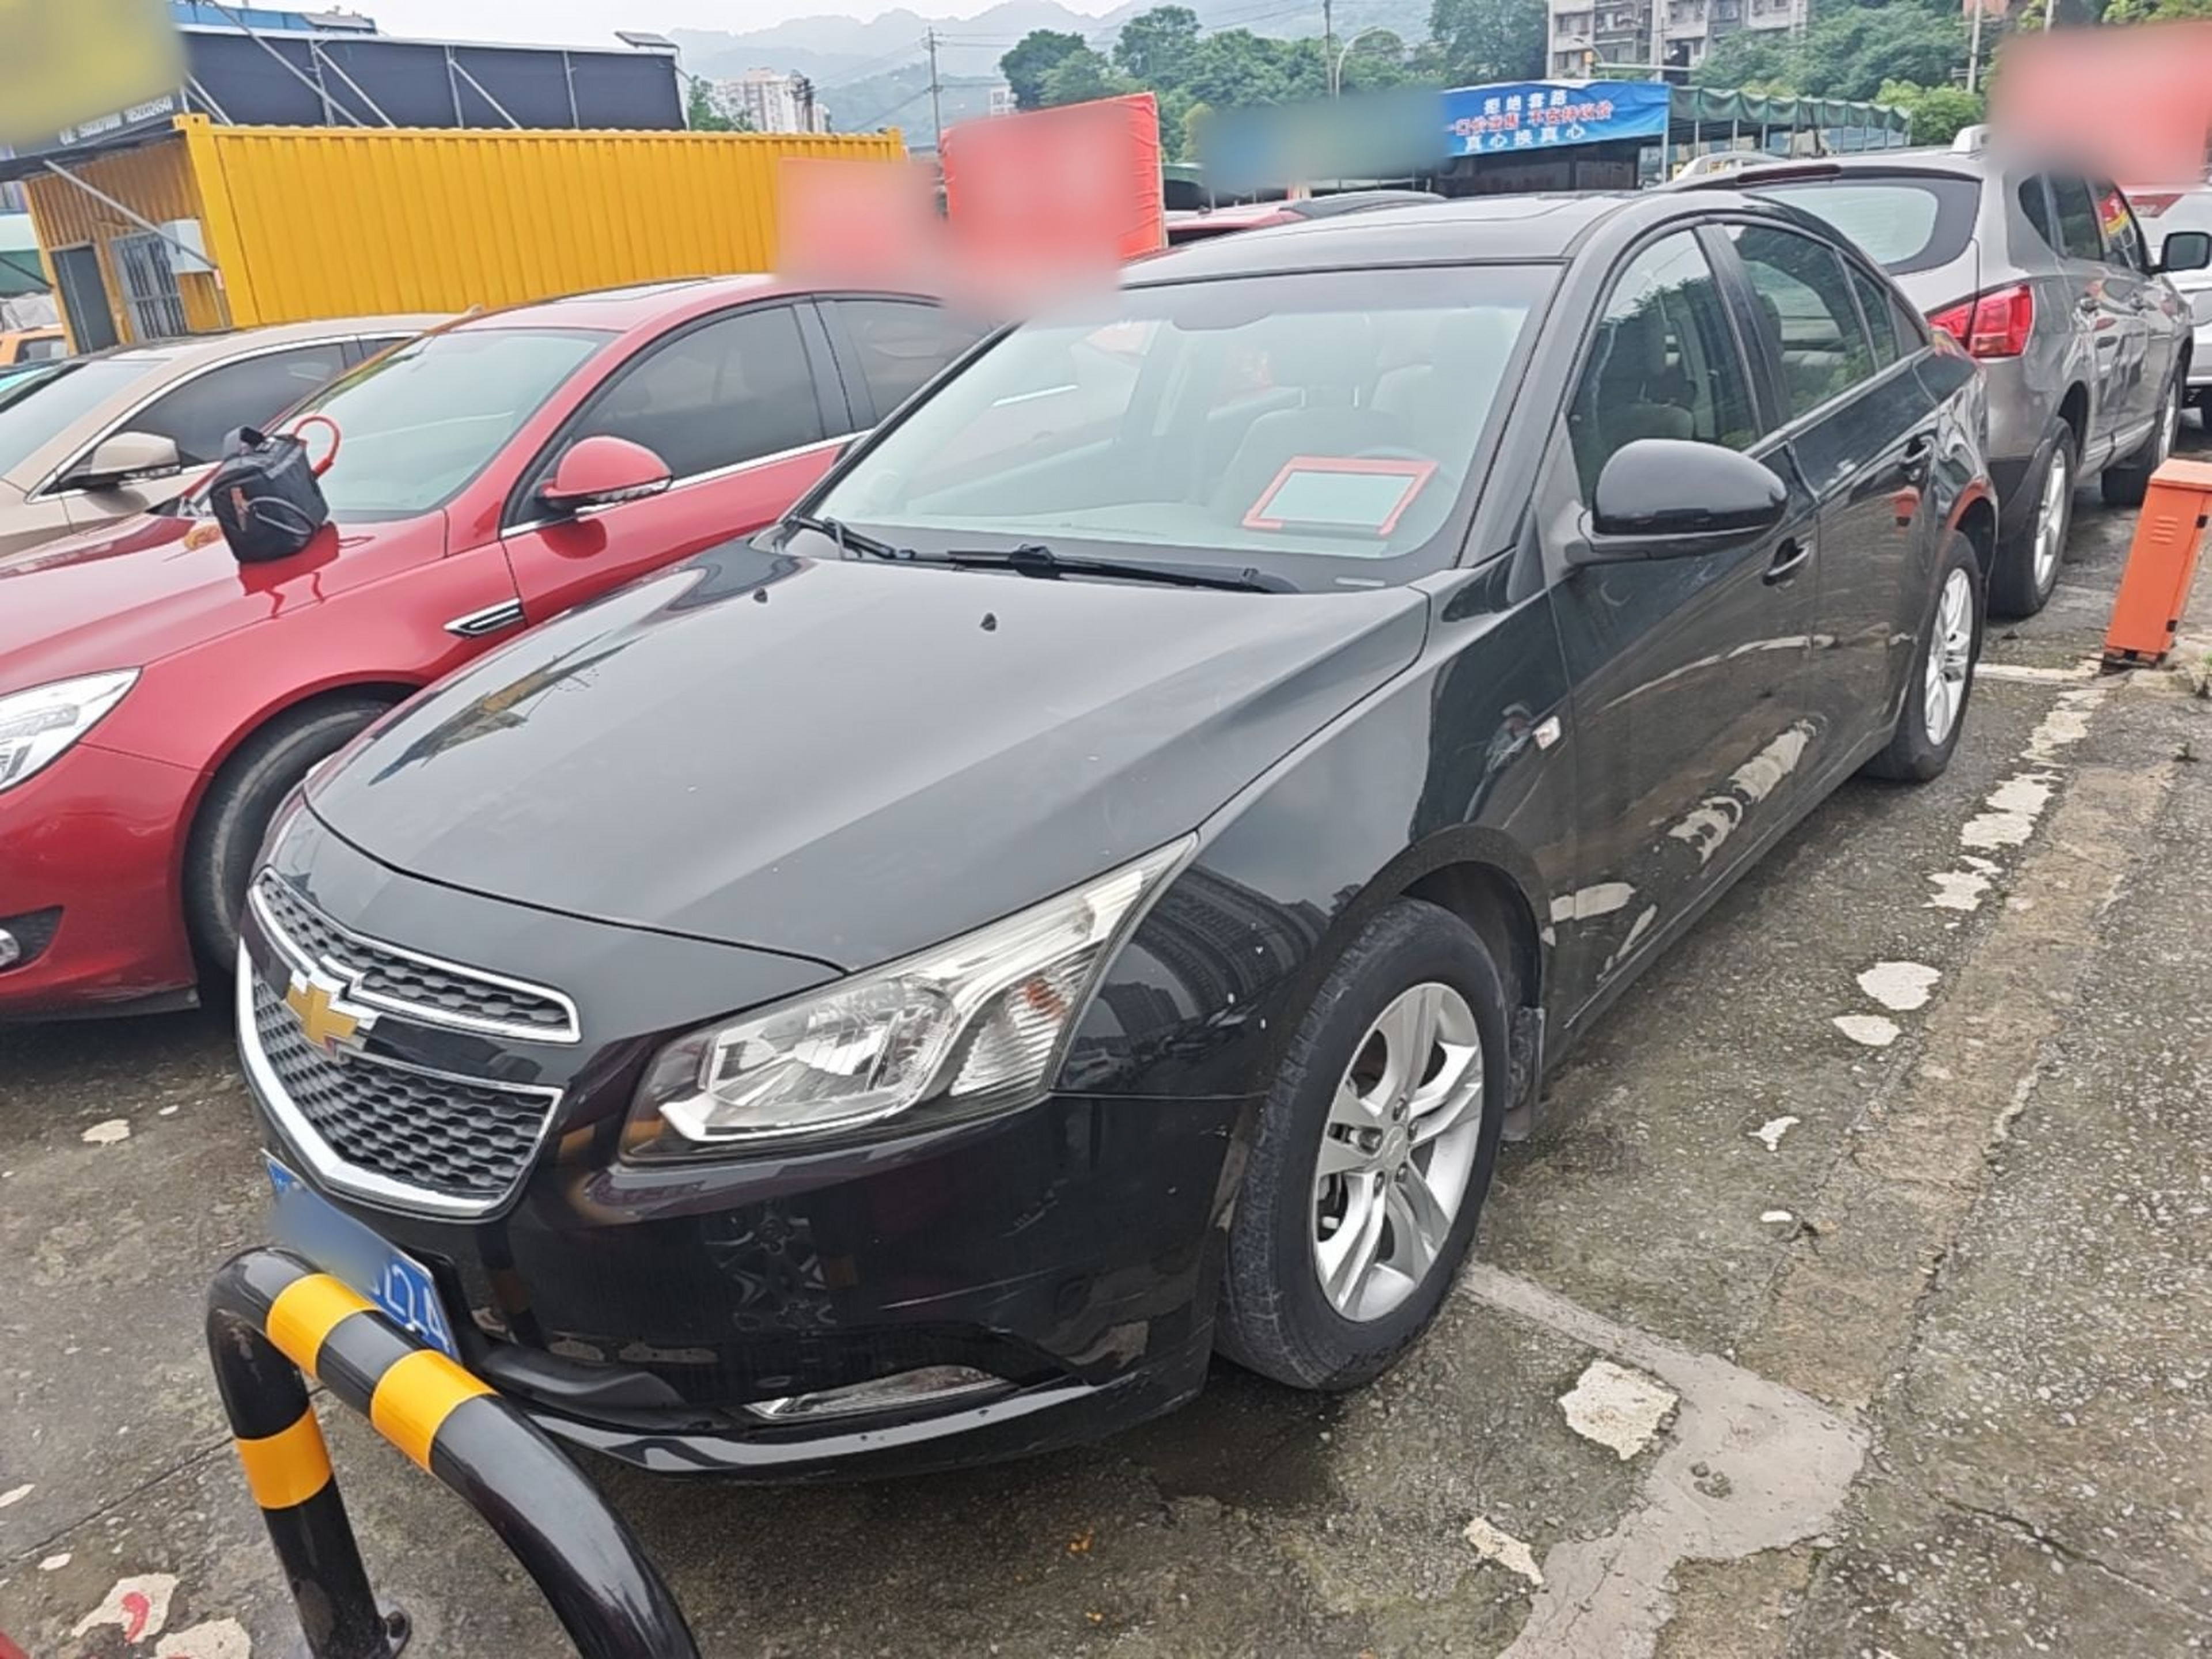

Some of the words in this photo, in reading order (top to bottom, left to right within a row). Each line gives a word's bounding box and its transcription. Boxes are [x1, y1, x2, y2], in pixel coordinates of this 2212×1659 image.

[1465, 124, 1586, 152] 真心换真心
